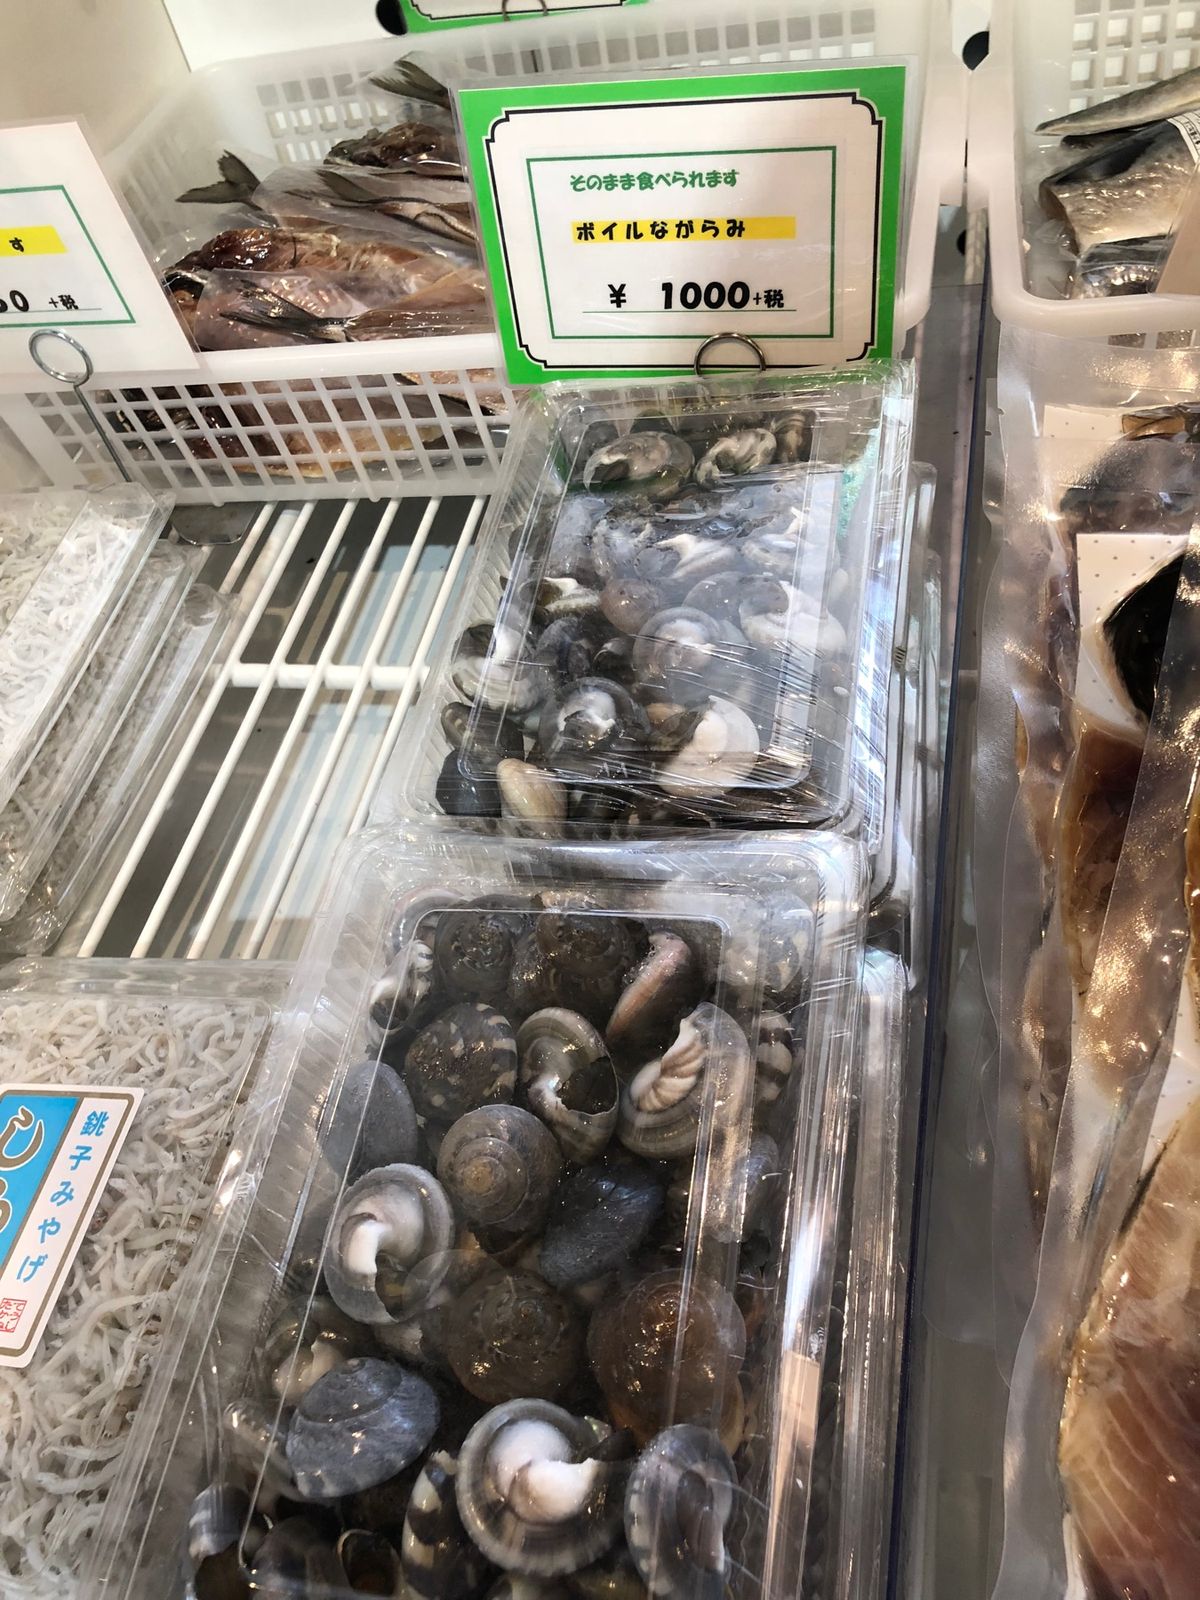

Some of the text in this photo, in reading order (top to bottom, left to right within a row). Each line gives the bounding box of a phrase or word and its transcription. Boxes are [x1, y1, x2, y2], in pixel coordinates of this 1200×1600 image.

[570, 169, 740, 191] そのまま食べられます
[576, 218, 746, 241] ボイルながらみ
[16, 1110, 110, 1283] 銚子みやげ
